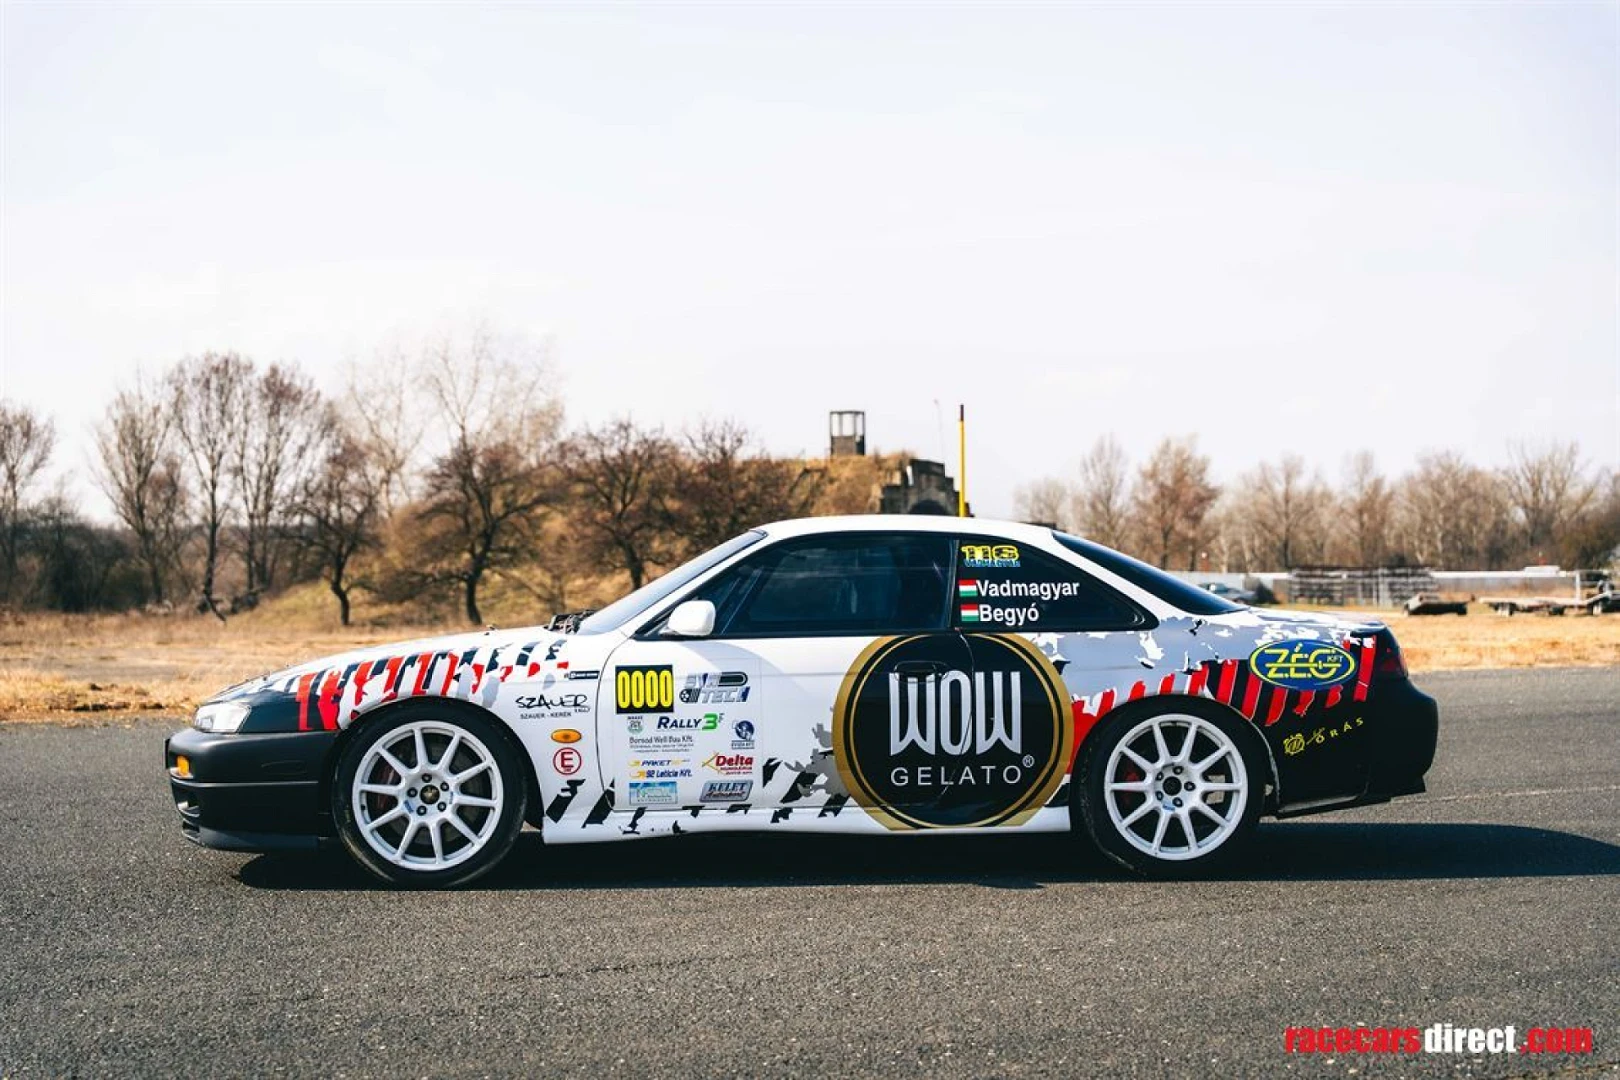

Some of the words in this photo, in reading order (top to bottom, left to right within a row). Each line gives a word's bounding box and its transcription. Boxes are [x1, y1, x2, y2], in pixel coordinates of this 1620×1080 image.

[976, 580, 1080, 600] Vadmagyar
[979, 602, 1039, 626] Begyó
[617, 670, 673, 709] 0000
[520, 712, 545, 720] SZAUER
[888, 670, 1022, 757] WOW
[715, 754, 753, 767] Delta
